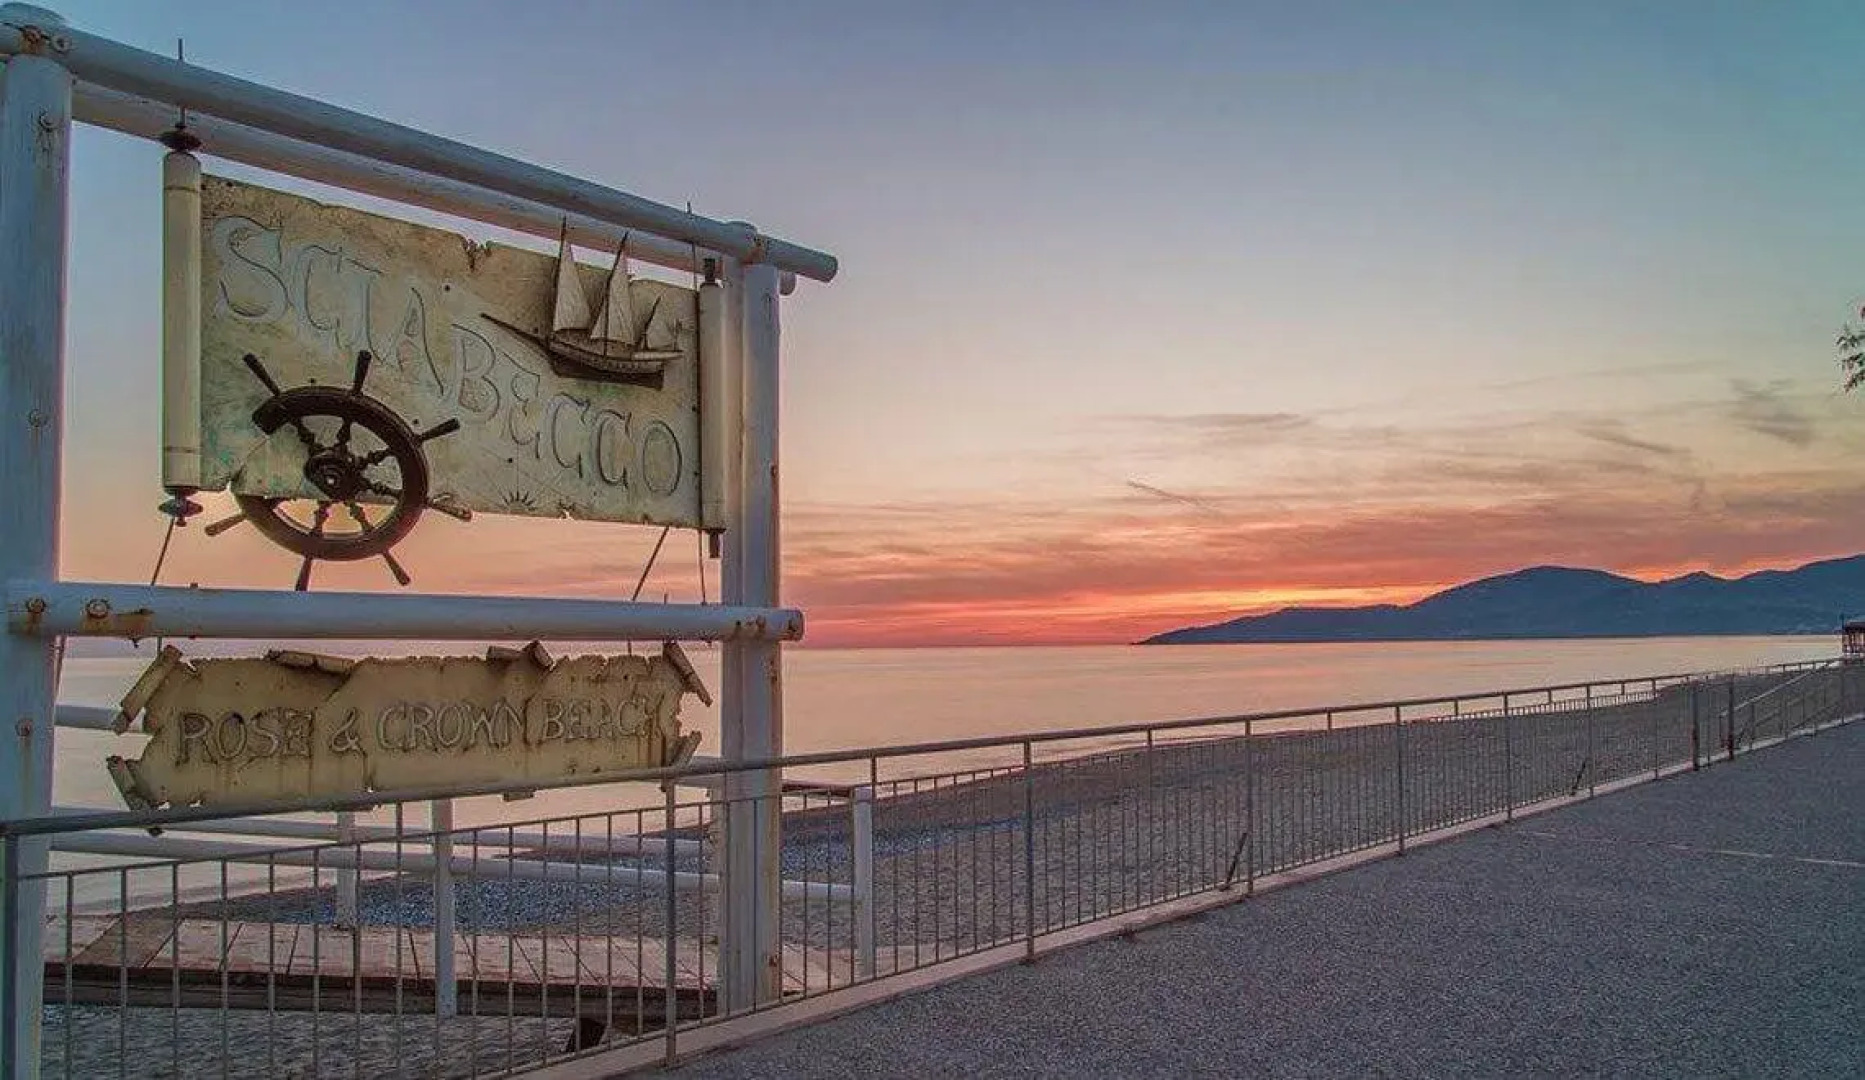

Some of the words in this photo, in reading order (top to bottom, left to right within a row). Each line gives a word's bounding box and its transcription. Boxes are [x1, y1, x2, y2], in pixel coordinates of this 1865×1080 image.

[175, 706, 314, 765] ROSE
[329, 706, 366, 757] &
[376, 698, 529, 753] CROWN
[541, 695, 665, 743] BEACH
